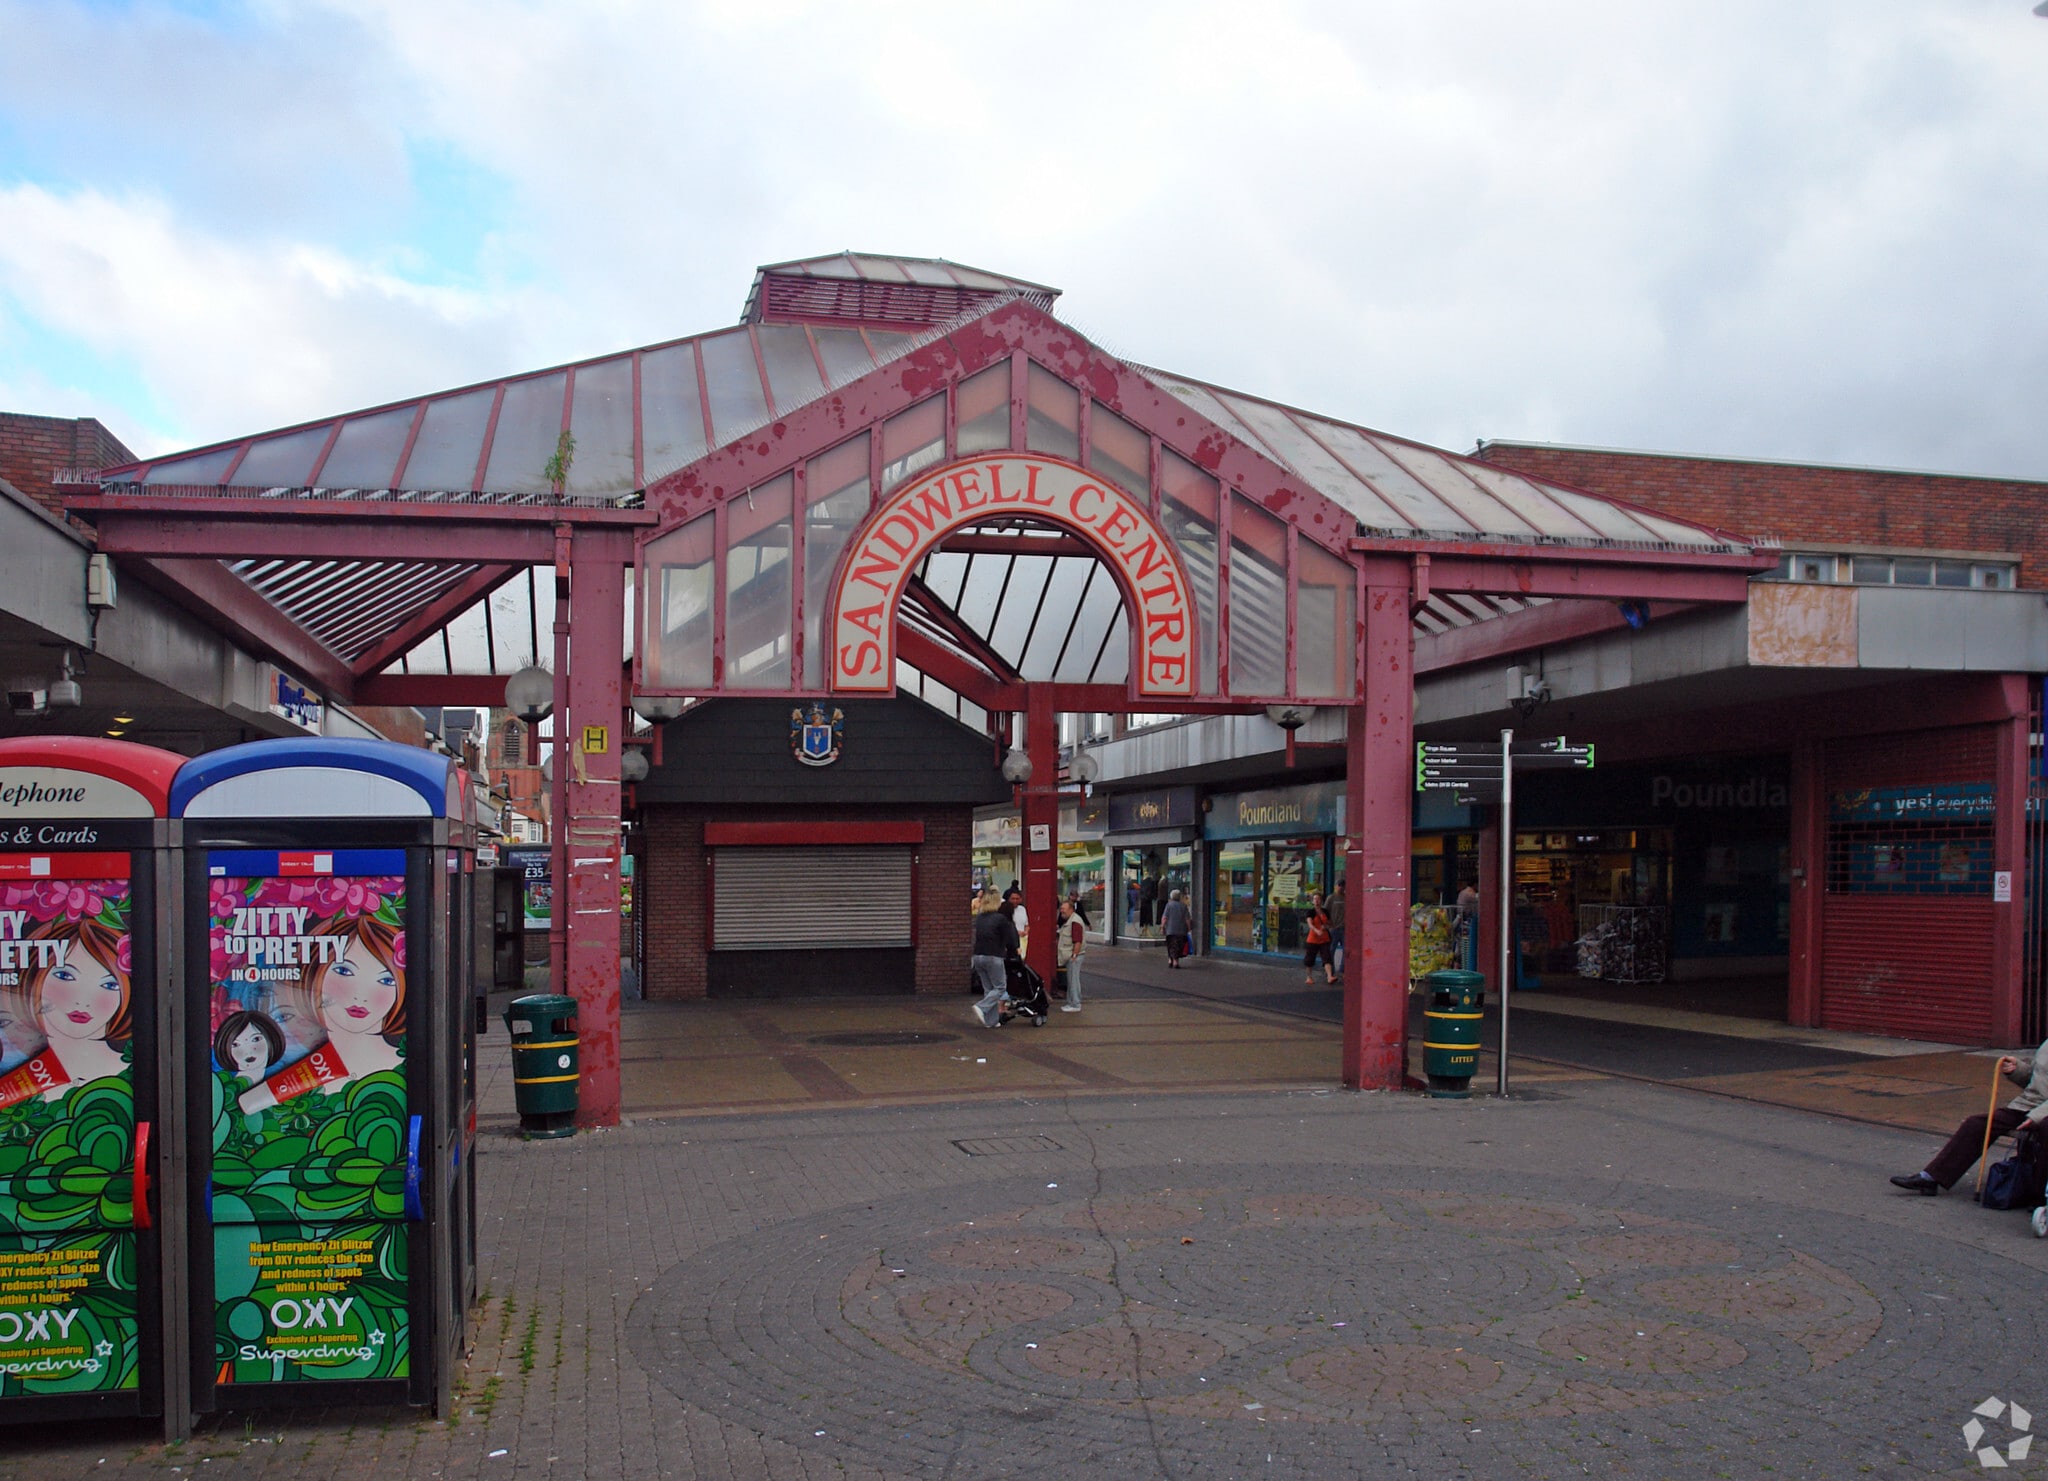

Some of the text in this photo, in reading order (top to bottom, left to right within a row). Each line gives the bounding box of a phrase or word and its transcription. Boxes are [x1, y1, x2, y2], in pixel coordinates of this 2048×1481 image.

[840, 463, 1186, 686] SANDWELL CENTRE
[586, 728, 604, 750] H
[1239, 801, 1301, 826] Poundland
[14, 826, 32, 844] &
[38, 826, 98, 844] Cards
[525, 867, 544, 878] £35
[232, 907, 308, 936] ZITTY
[0, 940, 69, 969] ETTY
[224, 935, 348, 965] to PRETTY
[231, 969, 243, 981] IN
[261, 968, 300, 981] HOURS
[1450, 1056, 1474, 1064] LITTER
[29, 1059, 56, 1088] OXY
[310, 1052, 335, 1082] OXY
[249, 1240, 373, 1253] New Emergency Zit Blitzer
[51, 1250, 64, 1261] Zit
[66, 1249, 100, 1261] Blitzer
[249, 1253, 373, 1266] from OXY reduces the size
[15, 1266, 58, 1276] reduces
[60, 1264, 78, 1274] the
[79, 1263, 100, 1273] size
[261, 1267, 363, 1279] and redness of spots
[1, 1278, 88, 1291] redness of spots
[275, 1282, 307, 1293] within
[308, 1282, 315, 1291] 4
[30, 1293, 38, 1303] 4
[270, 1297, 354, 1329] OXY
[266, 1335, 308, 1344] Exclusively
[239, 1344, 375, 1363] Superdrug
